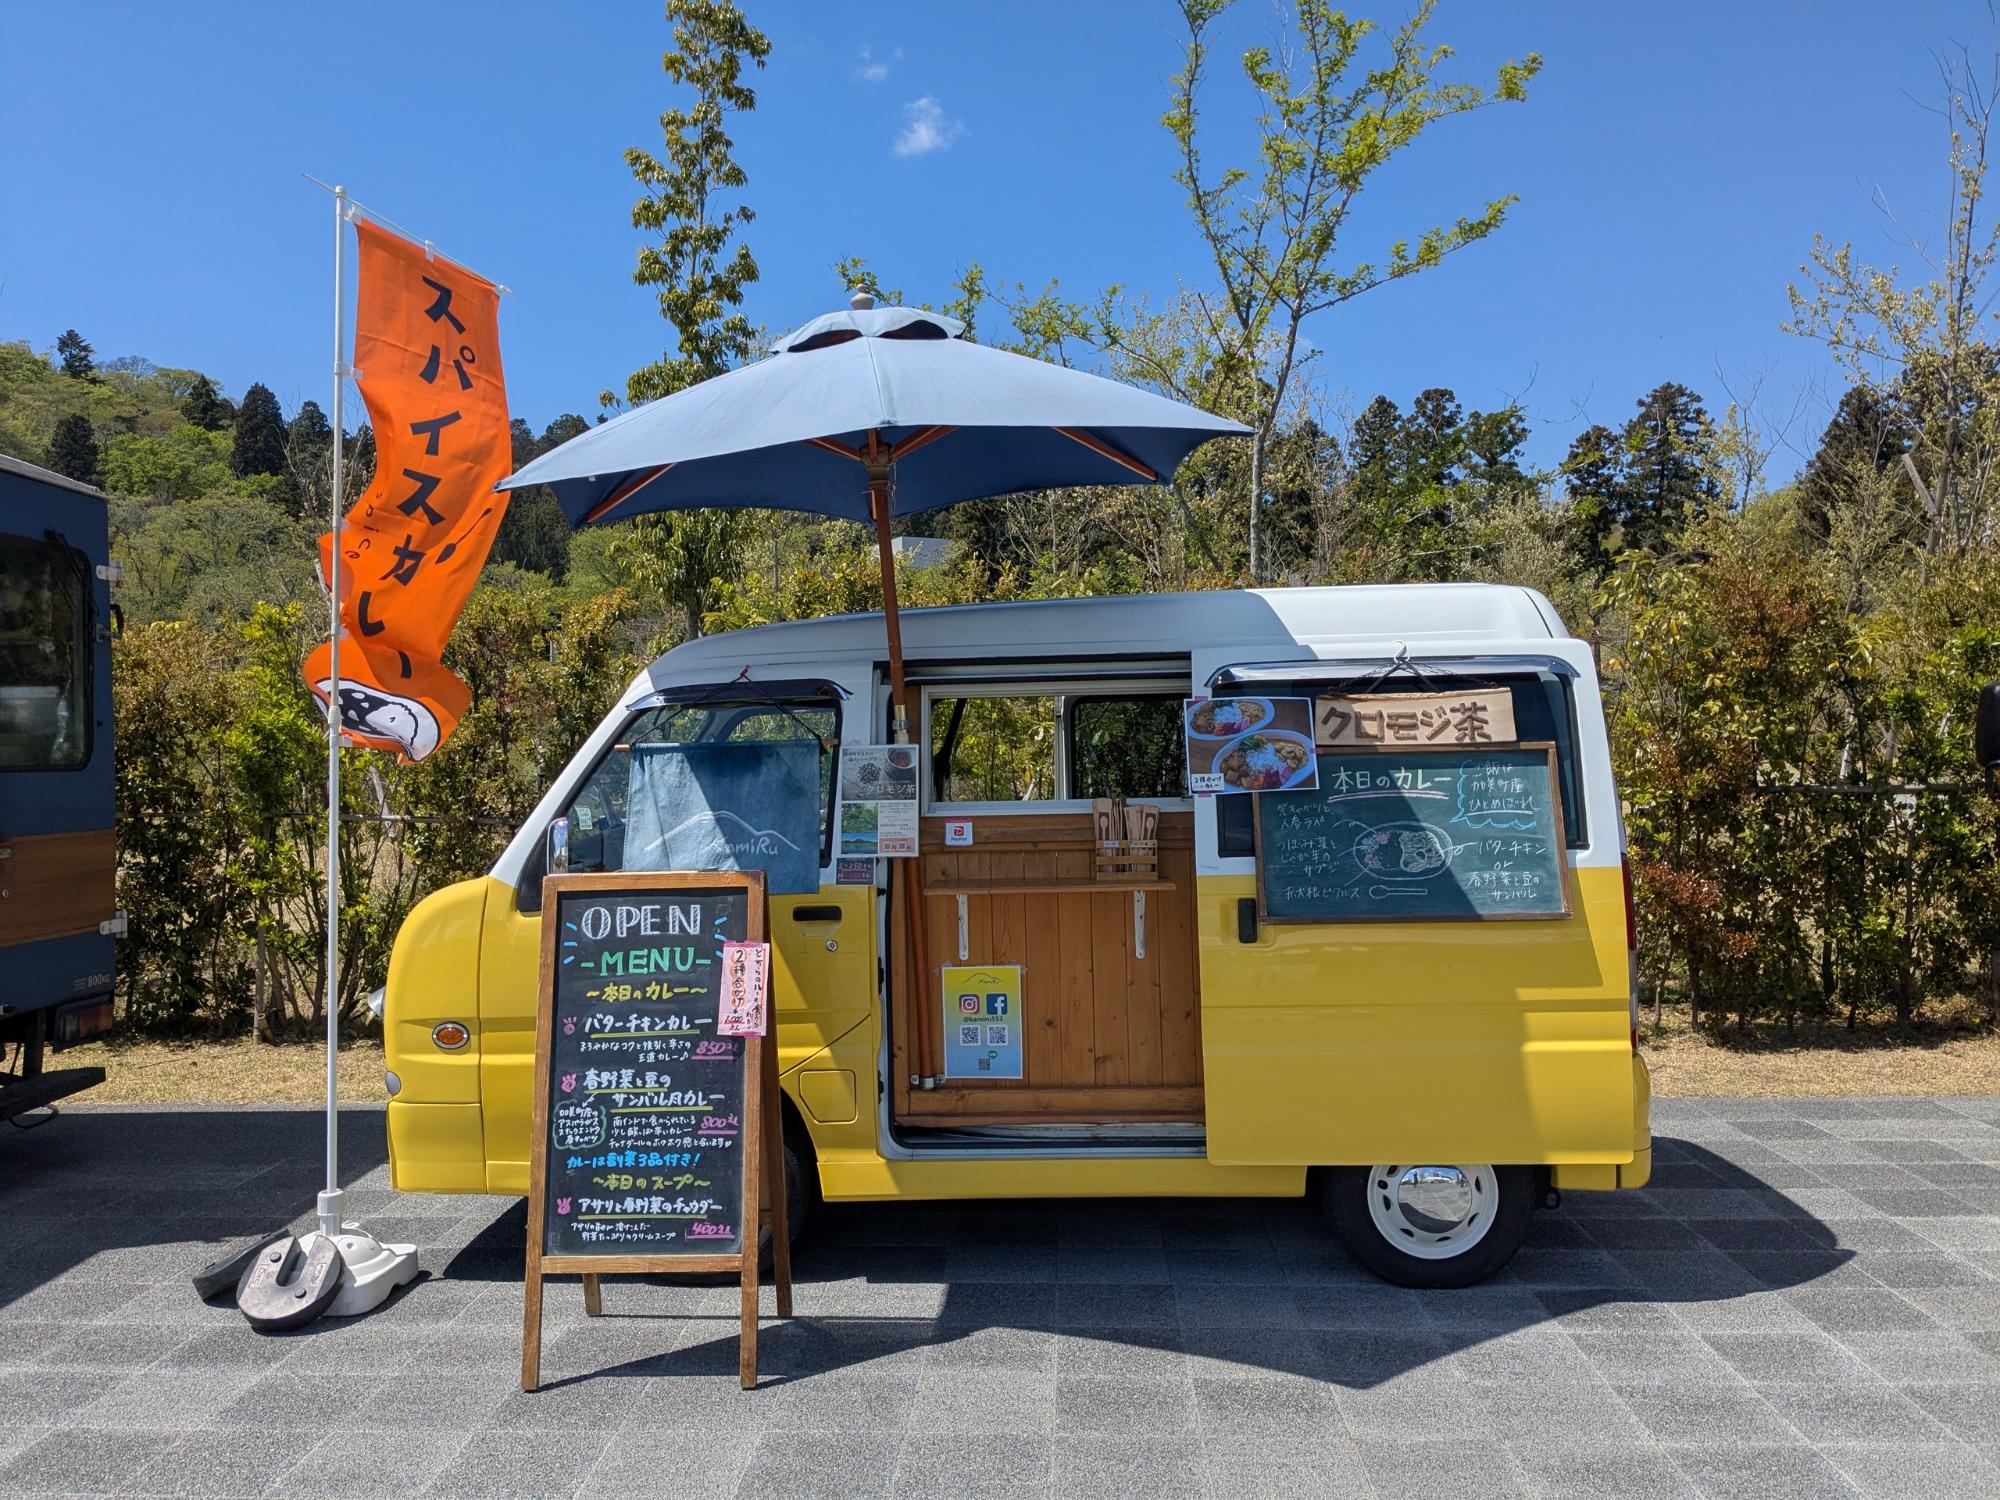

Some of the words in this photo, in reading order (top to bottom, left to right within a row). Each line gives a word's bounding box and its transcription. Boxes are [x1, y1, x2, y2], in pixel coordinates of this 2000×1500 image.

[359, 275, 476, 679] スパイスカレー
[1321, 701, 1492, 742] クロモジ茶
[1472, 761, 1514, 777] ご飯は
[1331, 766, 1452, 793] 本日のカレー
[1471, 777, 1524, 793] 加美町産
[866, 784, 916, 794] クロモジ茶
[1468, 795, 1542, 812] ひとめぼれ
[1280, 816, 1325, 831] 人参ラペ
[1478, 839, 1546, 857] バターチキン
[1281, 850, 1331, 865] じゃが芋の
[1494, 861, 1514, 870] or
[1303, 862, 1340, 877] サブジ
[1467, 871, 1540, 889] 春野菜と豆の
[1491, 889, 1537, 902] サンバル
[581, 904, 701, 940] OPEN
[585, 1014, 712, 1033] バターチキンカレー
[580, 1039, 691, 1052] まろやかなコクと後引く辛さの
[583, 1068, 671, 1088] 春野菜と豆の
[558, 1117, 599, 1128] アスパラガス
[613, 1115, 696, 1127] 南インドで食べられている
[577, 1196, 723, 1215] アサリと春野菜のチャウダー
[582, 1231, 677, 1242] 野菜たっぷりのクリームスープ
